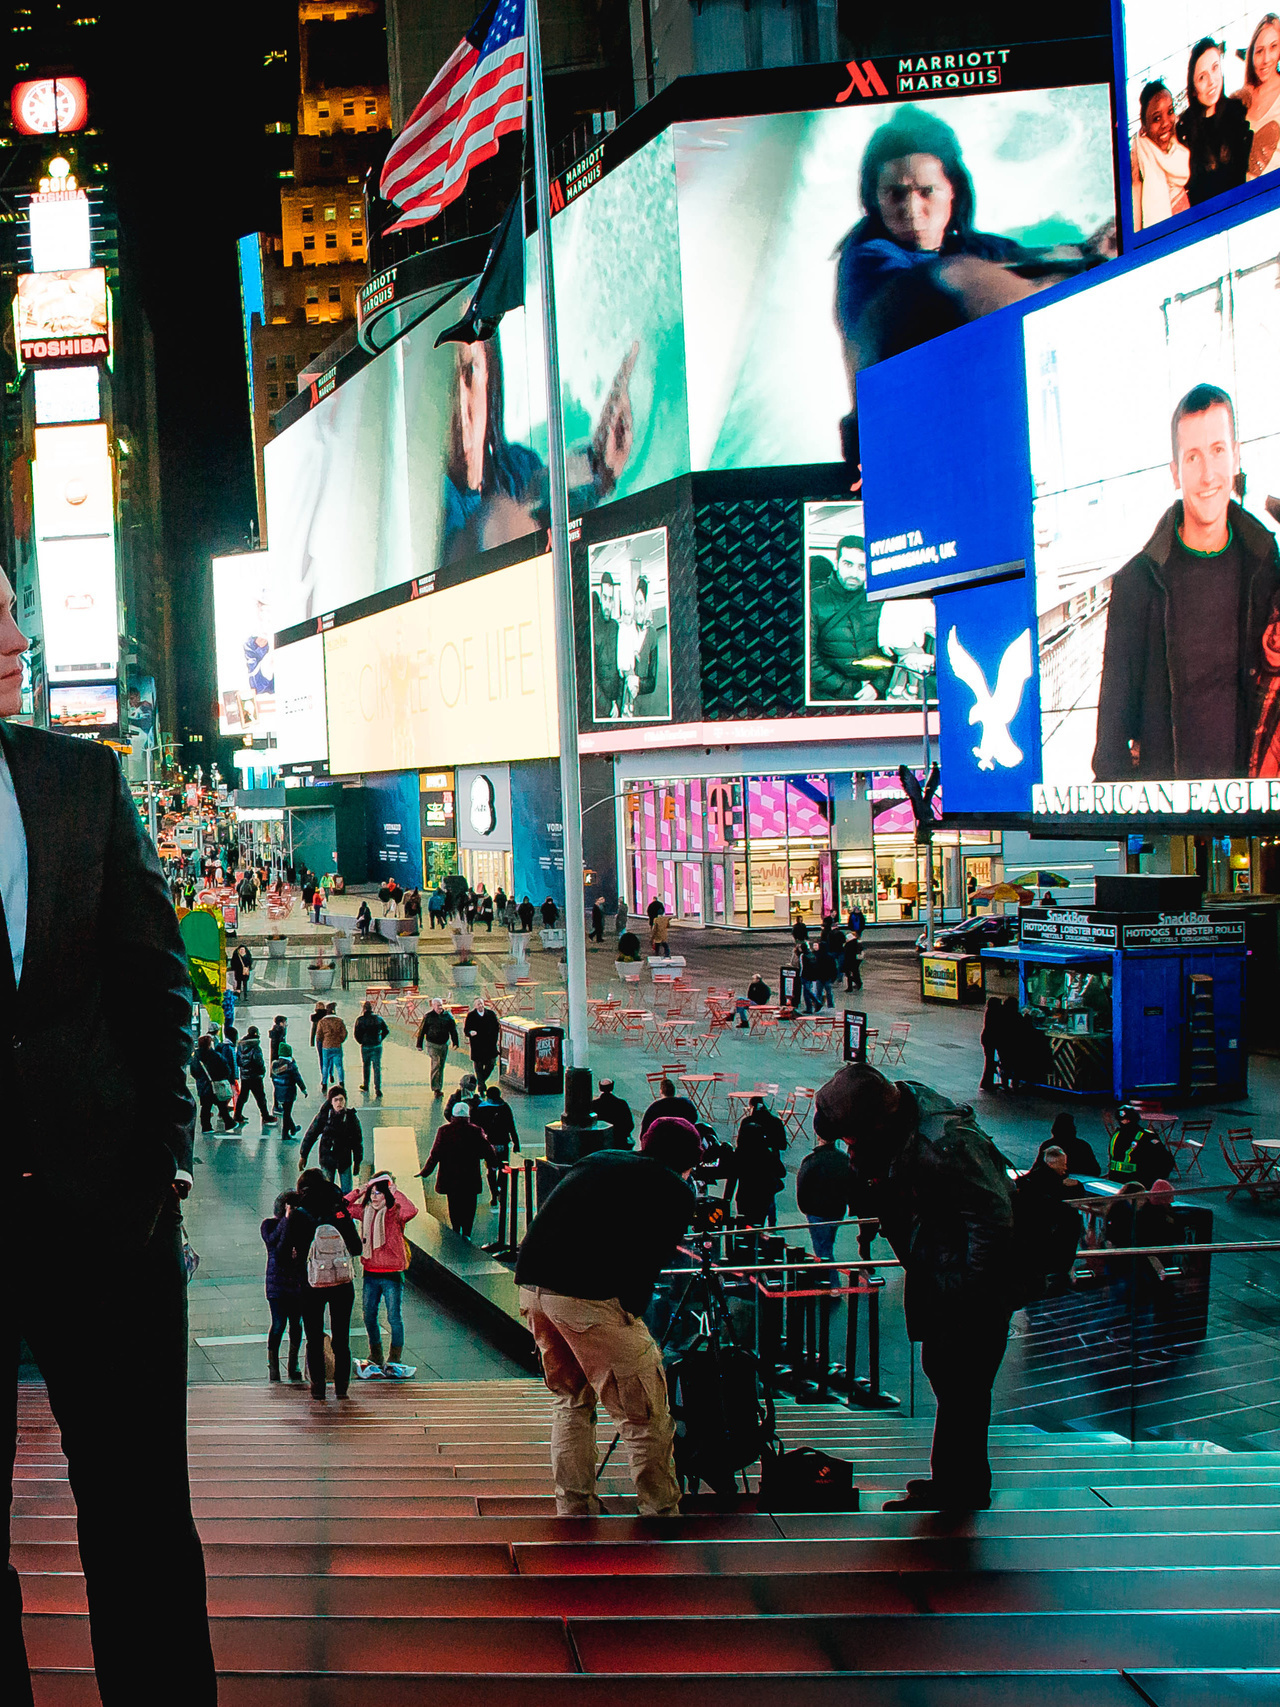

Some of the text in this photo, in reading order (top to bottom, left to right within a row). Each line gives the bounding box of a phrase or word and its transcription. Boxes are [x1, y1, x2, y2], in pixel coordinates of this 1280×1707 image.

[899, 49, 1010, 73] MARRIOTT
[900, 70, 997, 91] MARQUIS
[566, 144, 605, 185] MARRIOTT
[39, 175, 77, 193] 2016
[567, 165, 600, 201] MARQUIS
[30, 189, 87, 203] TOSHIBA
[362, 268, 398, 300] MARRIOTT
[363, 287, 392, 315] MARQUIS
[21, 337, 107, 358] TOSHIBA
[939, 541, 957, 559] UK
[359, 620, 535, 722] CIRLE OF LIFE
[1033, 779, 1280, 814] AMERICAN EAGLE
[1047, 910, 1090, 924] SnackBox
[1158, 912, 1210, 925] SnackBox
[1023, 922, 1115, 938] HOTDOGS LOBSTER ROLLS
[1126, 925, 1243, 938] HOTDOGS LOBSTER ROLLS
[1076, 1014, 1086, 1026] A
